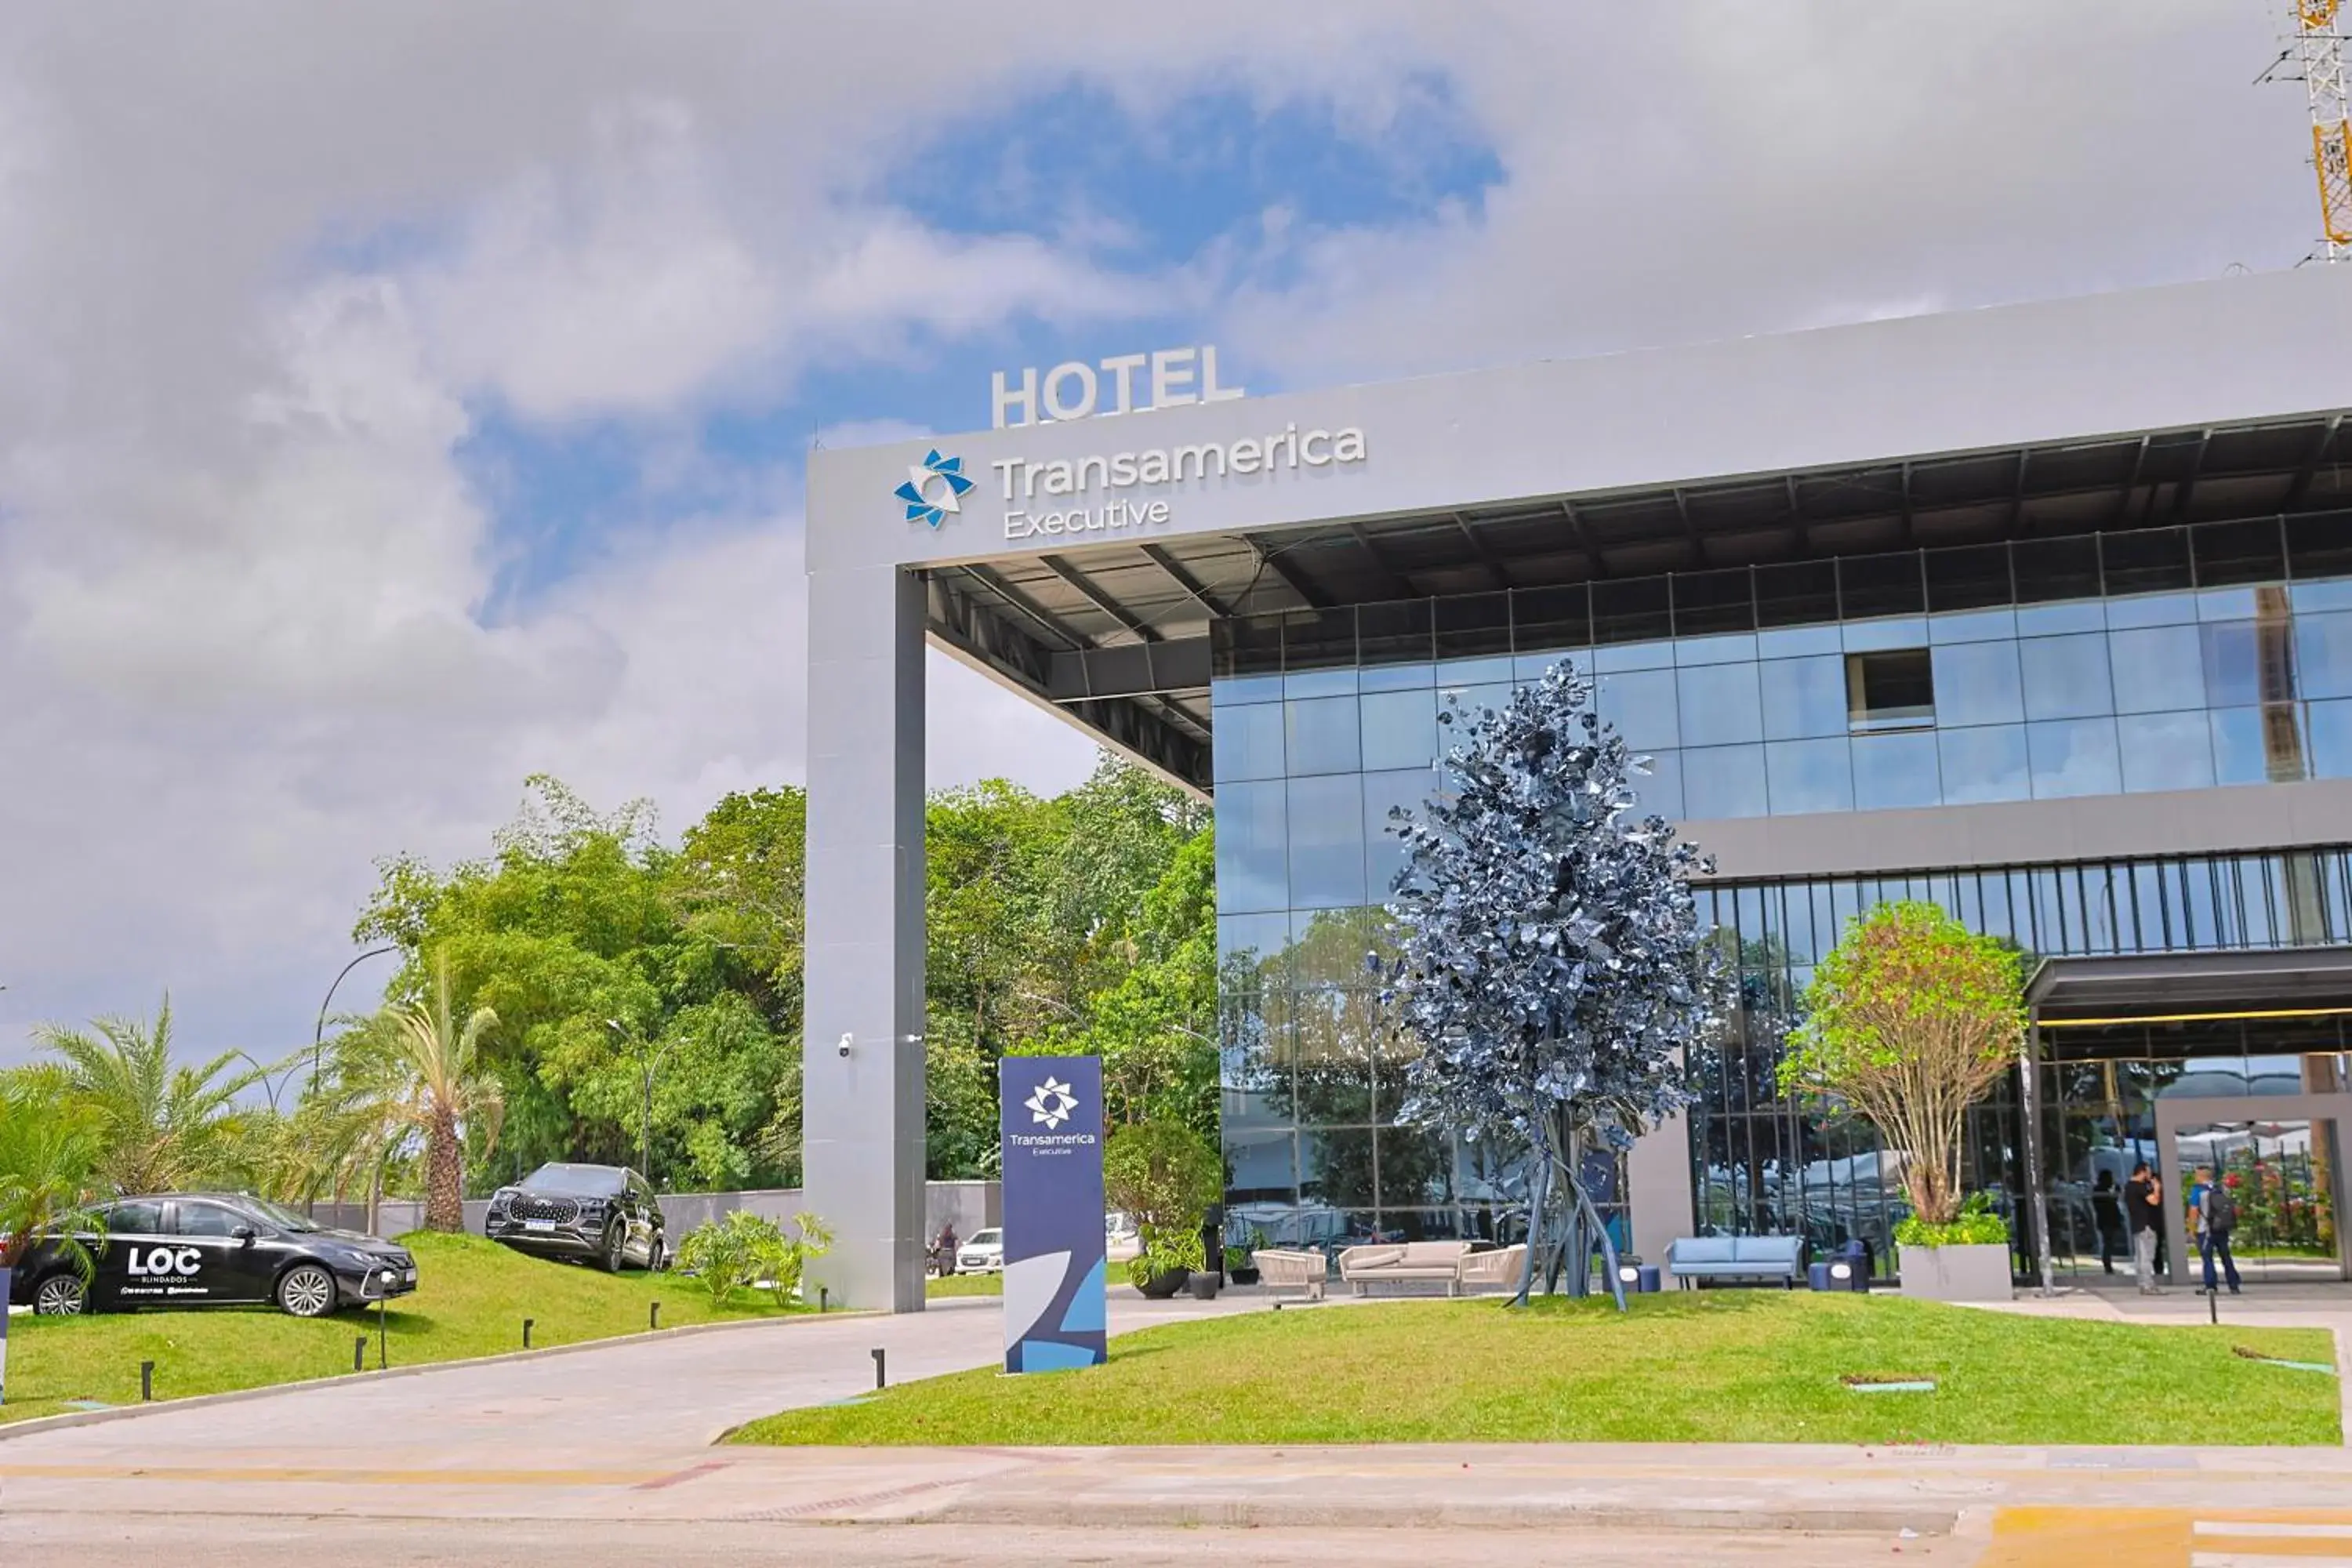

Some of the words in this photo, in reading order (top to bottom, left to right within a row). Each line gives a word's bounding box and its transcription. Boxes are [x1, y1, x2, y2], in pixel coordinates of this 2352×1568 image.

[992, 345, 1245, 429] HOTEL
[991, 422, 1366, 499] Transamerica
[1004, 498, 1170, 539] Executive
[1010, 1133, 1095, 1145] Transamerica
[1033, 1147, 1072, 1156] Executive
[128, 1247, 201, 1276] LOC
